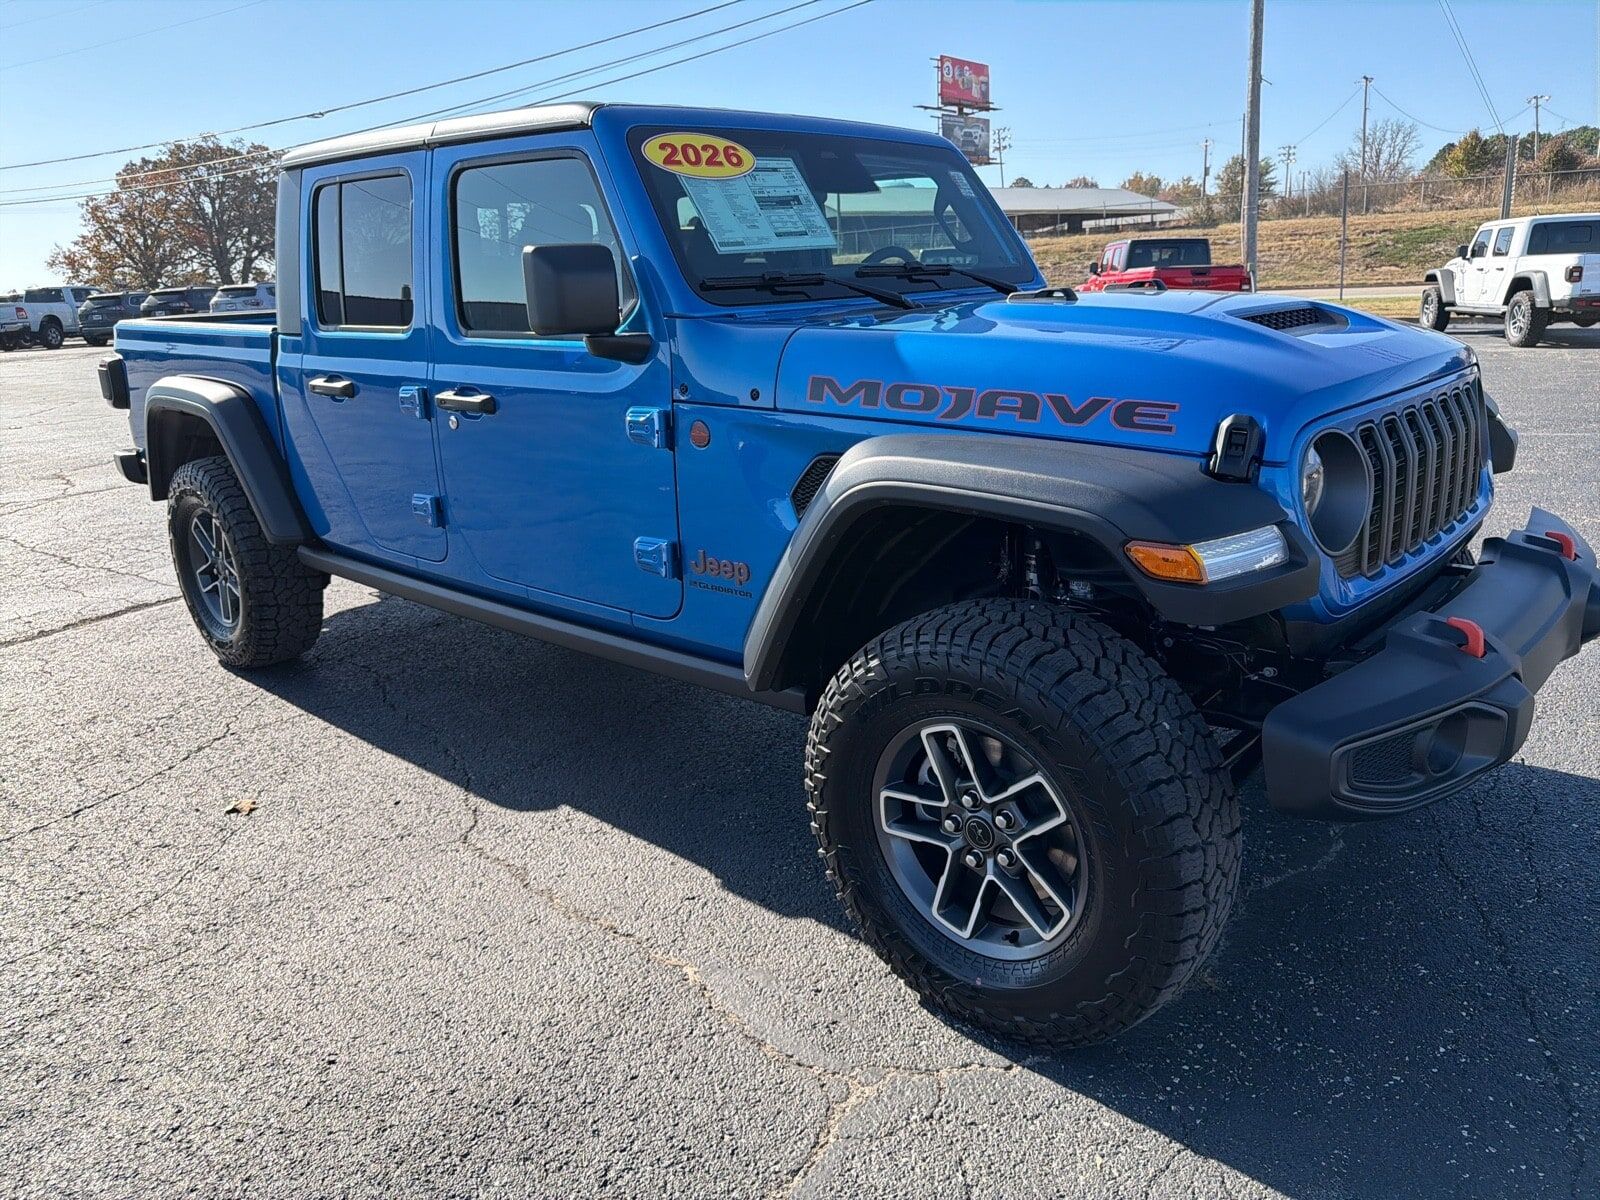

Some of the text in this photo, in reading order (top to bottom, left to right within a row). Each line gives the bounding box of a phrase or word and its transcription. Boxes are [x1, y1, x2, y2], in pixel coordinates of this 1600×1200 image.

[658, 142, 745, 169] 2026
[807, 375, 1180, 436] MOJAVE
[690, 549, 751, 587] Jeep
[699, 581, 753, 599] GLADIATOR
